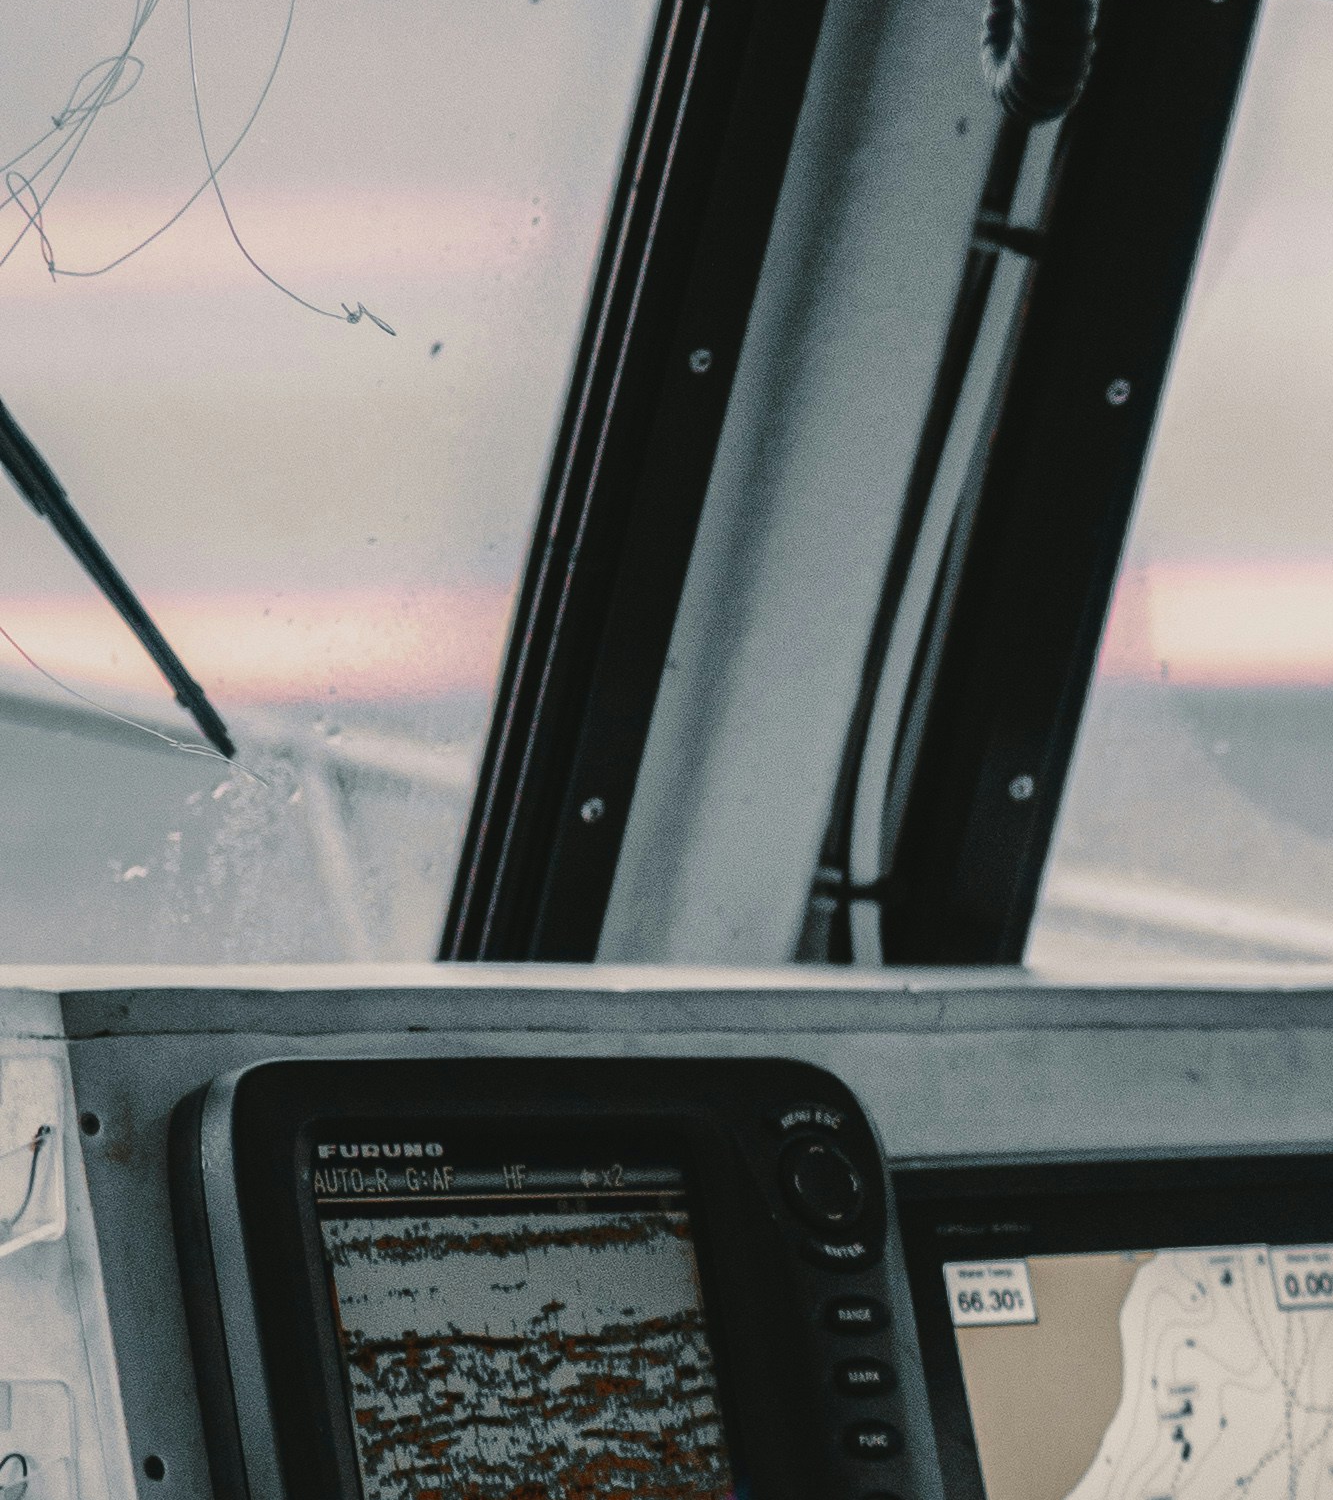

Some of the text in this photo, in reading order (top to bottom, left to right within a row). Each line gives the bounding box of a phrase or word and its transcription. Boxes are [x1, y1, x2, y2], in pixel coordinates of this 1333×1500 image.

[317, 1141, 445, 1159] FURUNO
[503, 1164, 527, 1190] HF
[837, 1308, 872, 1322] RANGE
[848, 1369, 880, 1383] MARK
[858, 1434, 888, 1448] FUNC
